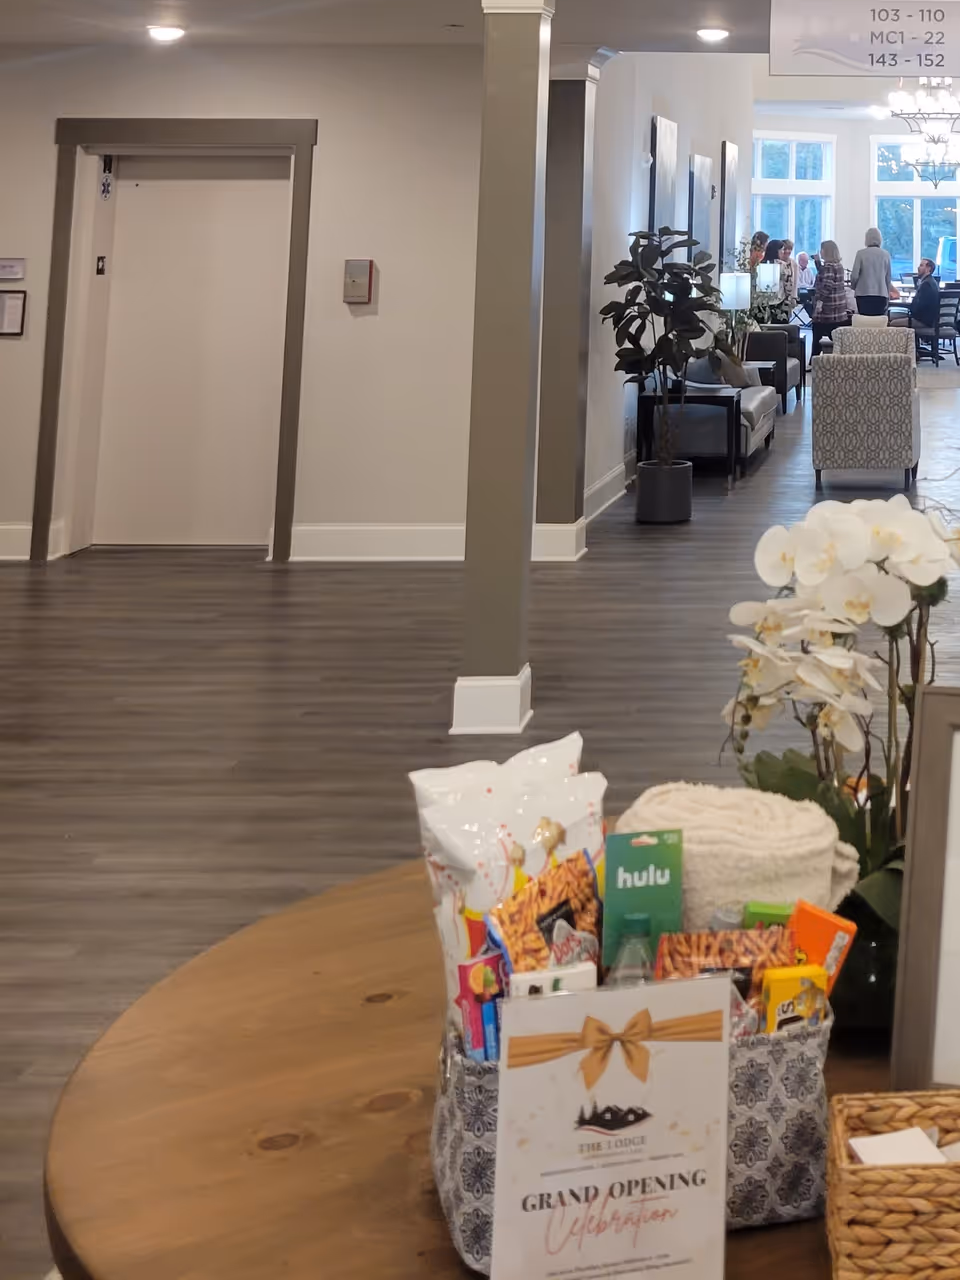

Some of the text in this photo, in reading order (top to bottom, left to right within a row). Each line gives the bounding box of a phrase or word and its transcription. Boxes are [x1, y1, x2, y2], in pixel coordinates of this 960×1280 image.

[870, 8, 901, 23] 103
[918, 8, 946, 23] 110
[870, 31, 905, 45] MC1
[923, 31, 946, 46] 22
[868, 53, 898, 67] 143
[917, 53, 946, 68] 152
[616, 863, 671, 889] hulu
[577, 1141, 603, 1155] THE
[605, 1135, 648, 1151] LODGE
[521, 1168, 707, 1213] GRAND OPENING
[544, 1188, 679, 1256] Celebration
